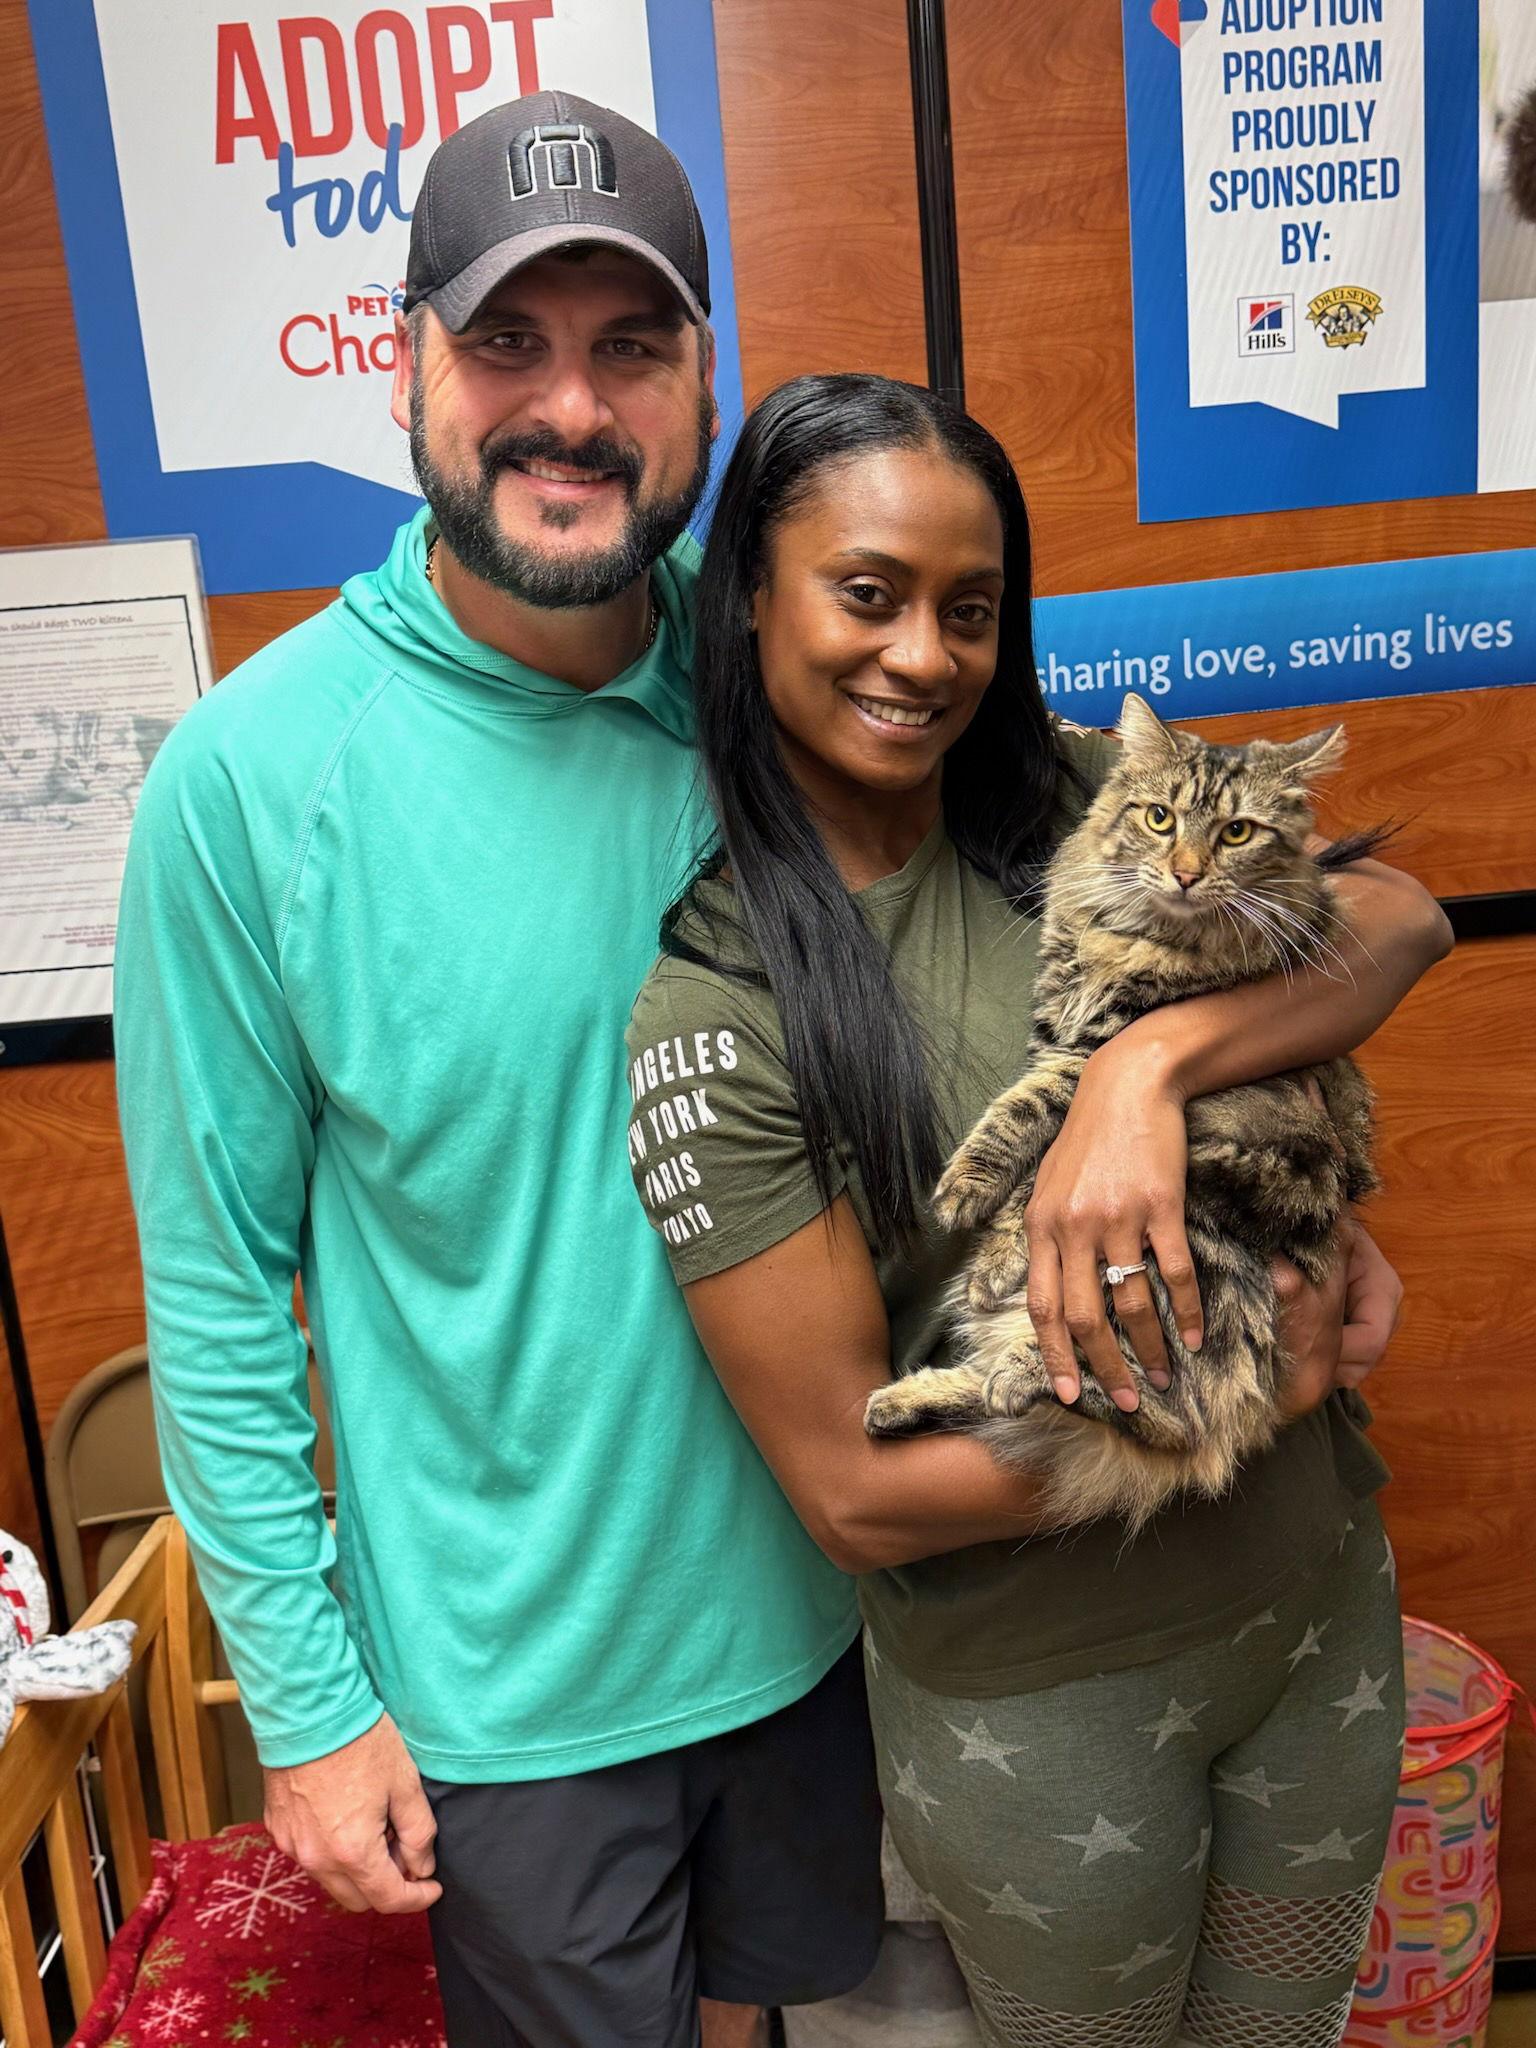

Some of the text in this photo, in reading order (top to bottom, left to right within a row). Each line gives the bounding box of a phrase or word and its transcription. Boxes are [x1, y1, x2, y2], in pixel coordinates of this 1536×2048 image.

[215, 0, 554, 164] ADOPT
[1223, 40, 1382, 94] PROGRAM
[1232, 100, 1376, 153] PROUDLY
[266, 122, 414, 247] tod
[1209, 157, 1400, 213] SPONSORED
[1281, 221, 1331, 265] BY:
[1248, 333, 1286, 351] Hill's
[72, 617, 97, 627] TWO
[1183, 638, 1276, 678] love,
[1289, 623, 1412, 670] saving
[1425, 613, 1513, 655] lives
[648, 1088, 718, 1146] YORK
